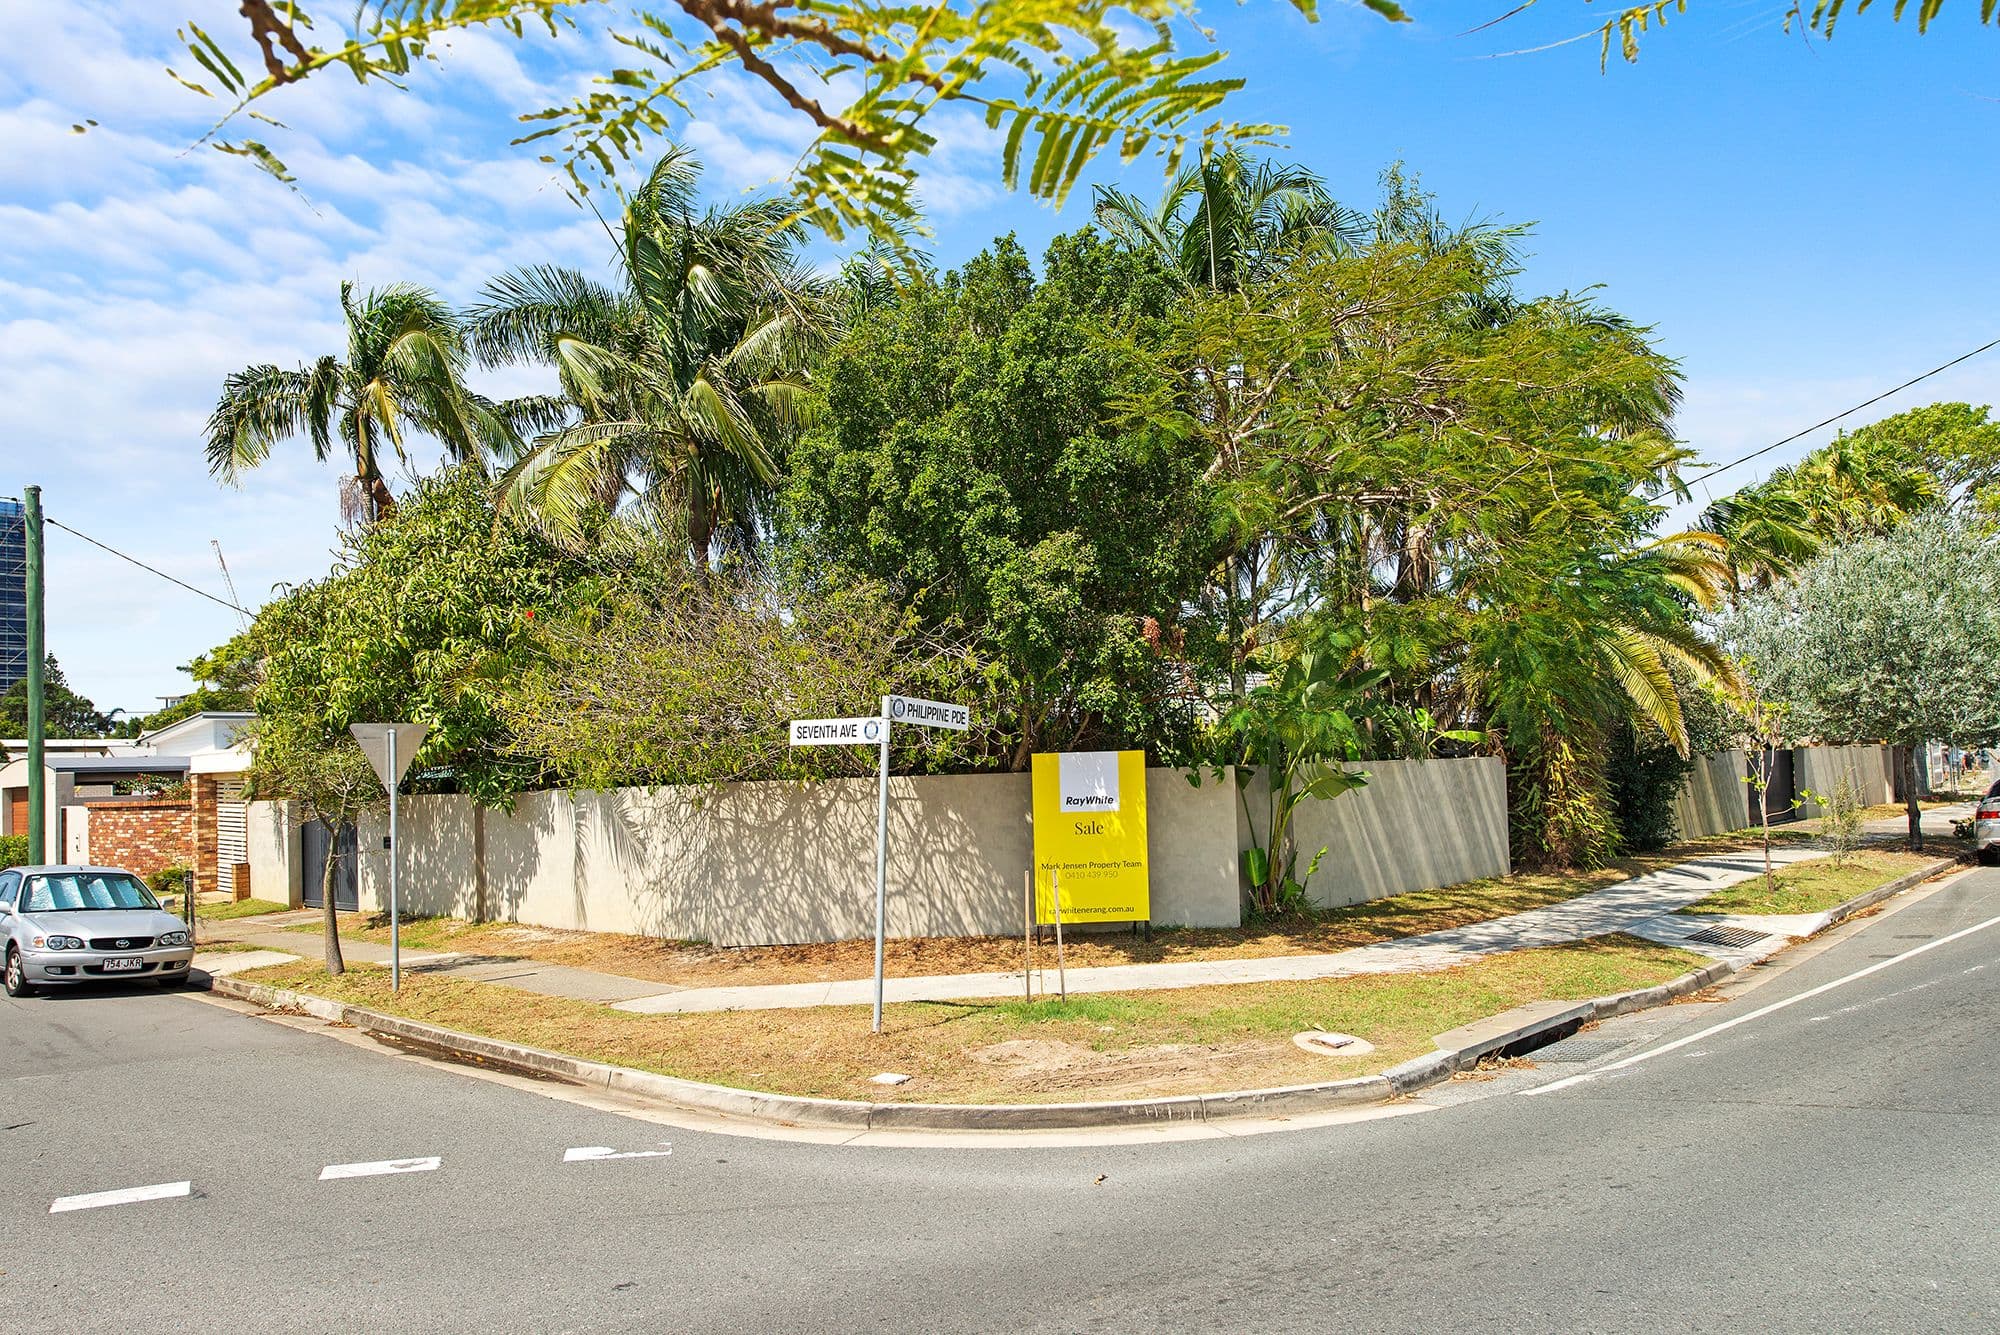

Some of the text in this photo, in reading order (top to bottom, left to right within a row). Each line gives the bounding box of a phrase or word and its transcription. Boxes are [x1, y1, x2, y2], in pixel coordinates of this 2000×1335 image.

[907, 703, 966, 725] PHILIPPINE PDE
[796, 724, 857, 739] SEVENTH AVE
[1075, 821, 1104, 835] Sale
[1062, 862, 1087, 870] Jensen
[1089, 861, 1121, 870] Property
[1122, 860, 1142, 868] Team
[1065, 871, 1085, 880] 0410
[1049, 906, 1134, 914] rawhitenerang.com.au
